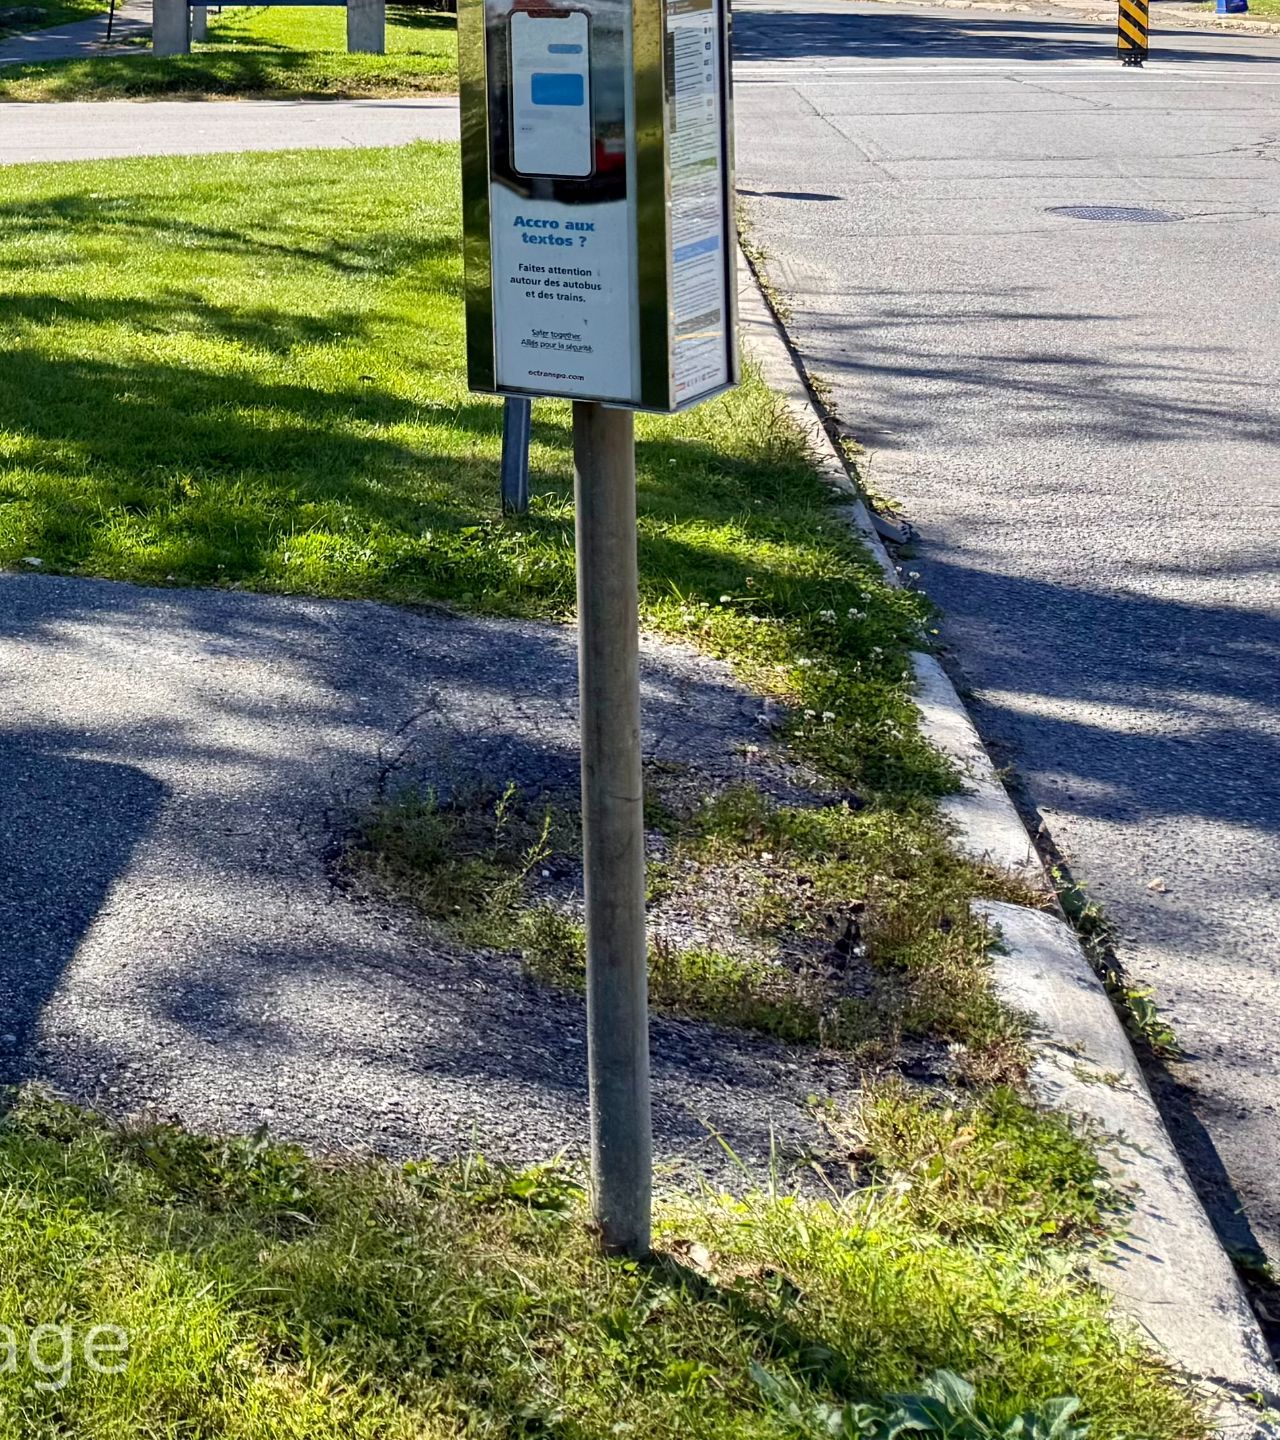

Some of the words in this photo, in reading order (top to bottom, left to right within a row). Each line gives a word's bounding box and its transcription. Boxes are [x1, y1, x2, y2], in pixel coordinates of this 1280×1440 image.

[513, 215, 559, 230] Accro
[564, 220, 595, 232] aux
[521, 232, 573, 247] textos
[578, 235, 587, 248] ?
[518, 263, 546, 274] Faites
[547, 265, 592, 277] attention
[510, 276, 542, 286] autour
[543, 277, 561, 288] des
[562, 279, 602, 291] autobus
[525, 290, 536, 299] et
[537, 290, 554, 300] des
[556, 292, 586, 302] trains.
[539, 341, 558, 350] pour
[527, 368, 585, 381] octranspo.com
